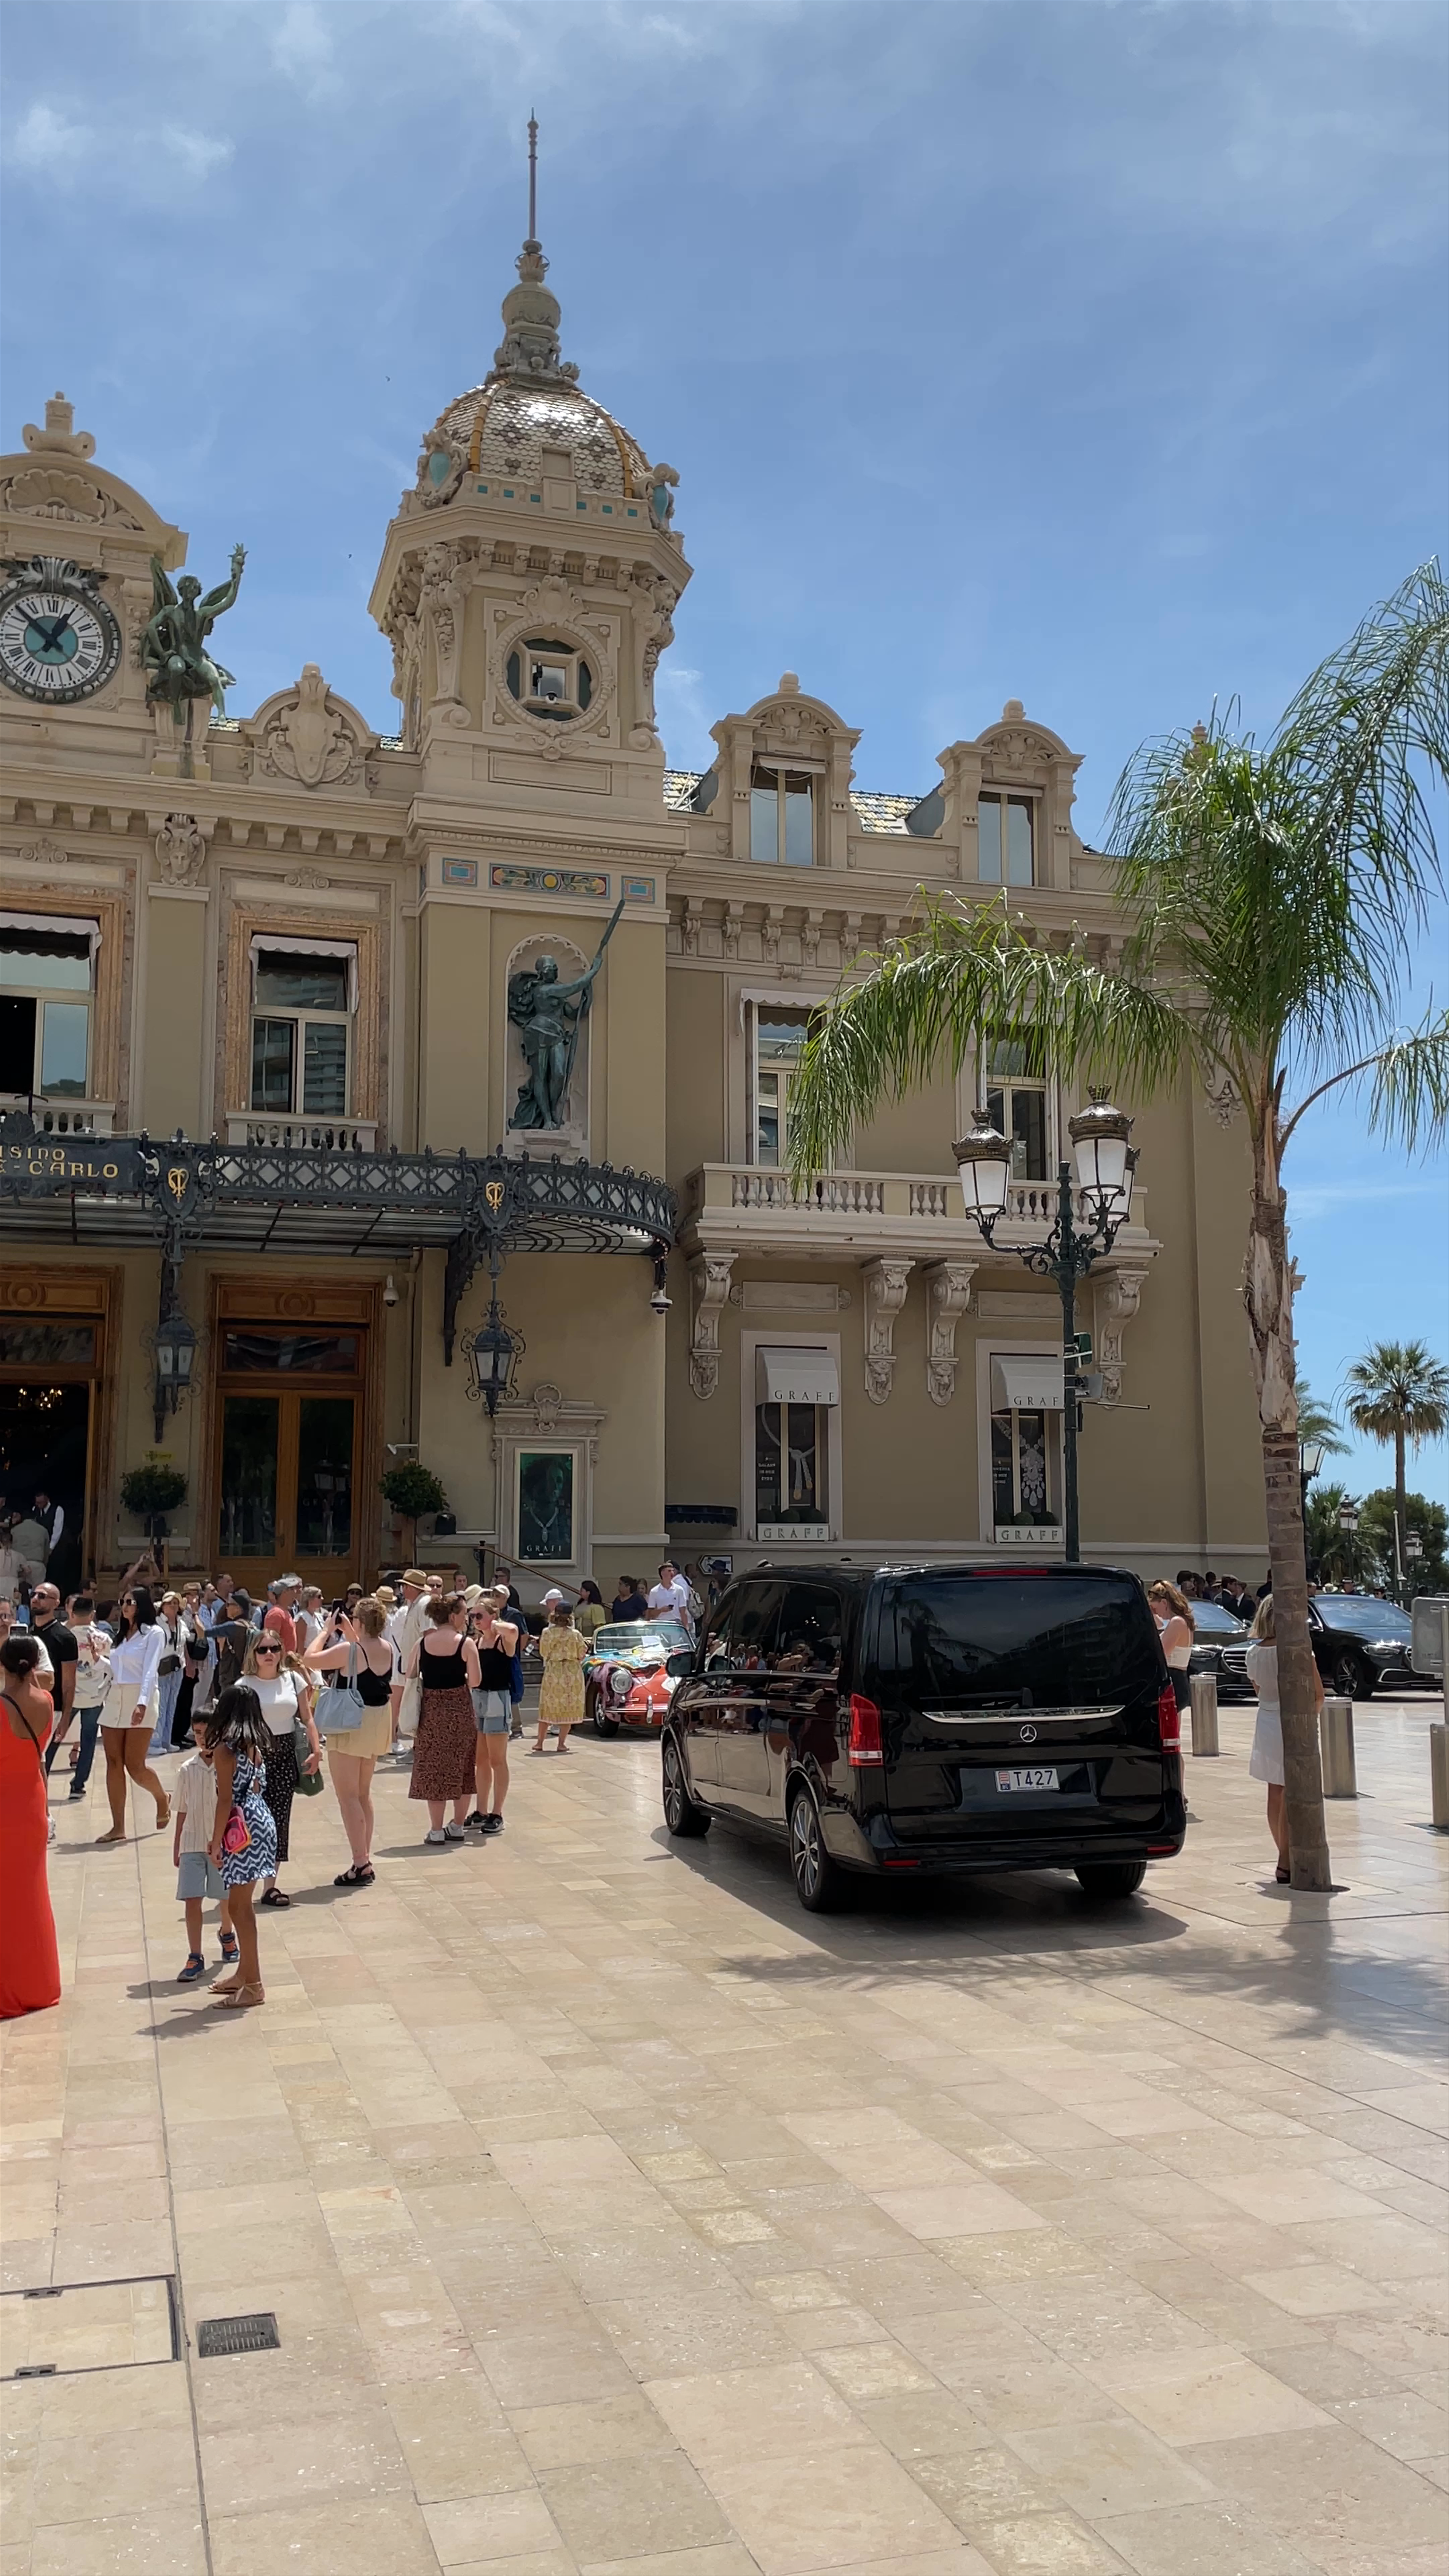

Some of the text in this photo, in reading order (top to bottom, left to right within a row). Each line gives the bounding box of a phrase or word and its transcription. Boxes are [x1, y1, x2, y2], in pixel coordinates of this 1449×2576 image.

[0, 1145, 65, 1161] SINO
[774, 1390, 835, 1401] GRAFF
[1014, 1396, 1059, 1406] GRAF
[763, 1527, 824, 1538] GRAFF
[1001, 1530, 1058, 1541] GRAFF
[1014, 1770, 1053, 1787] T427
